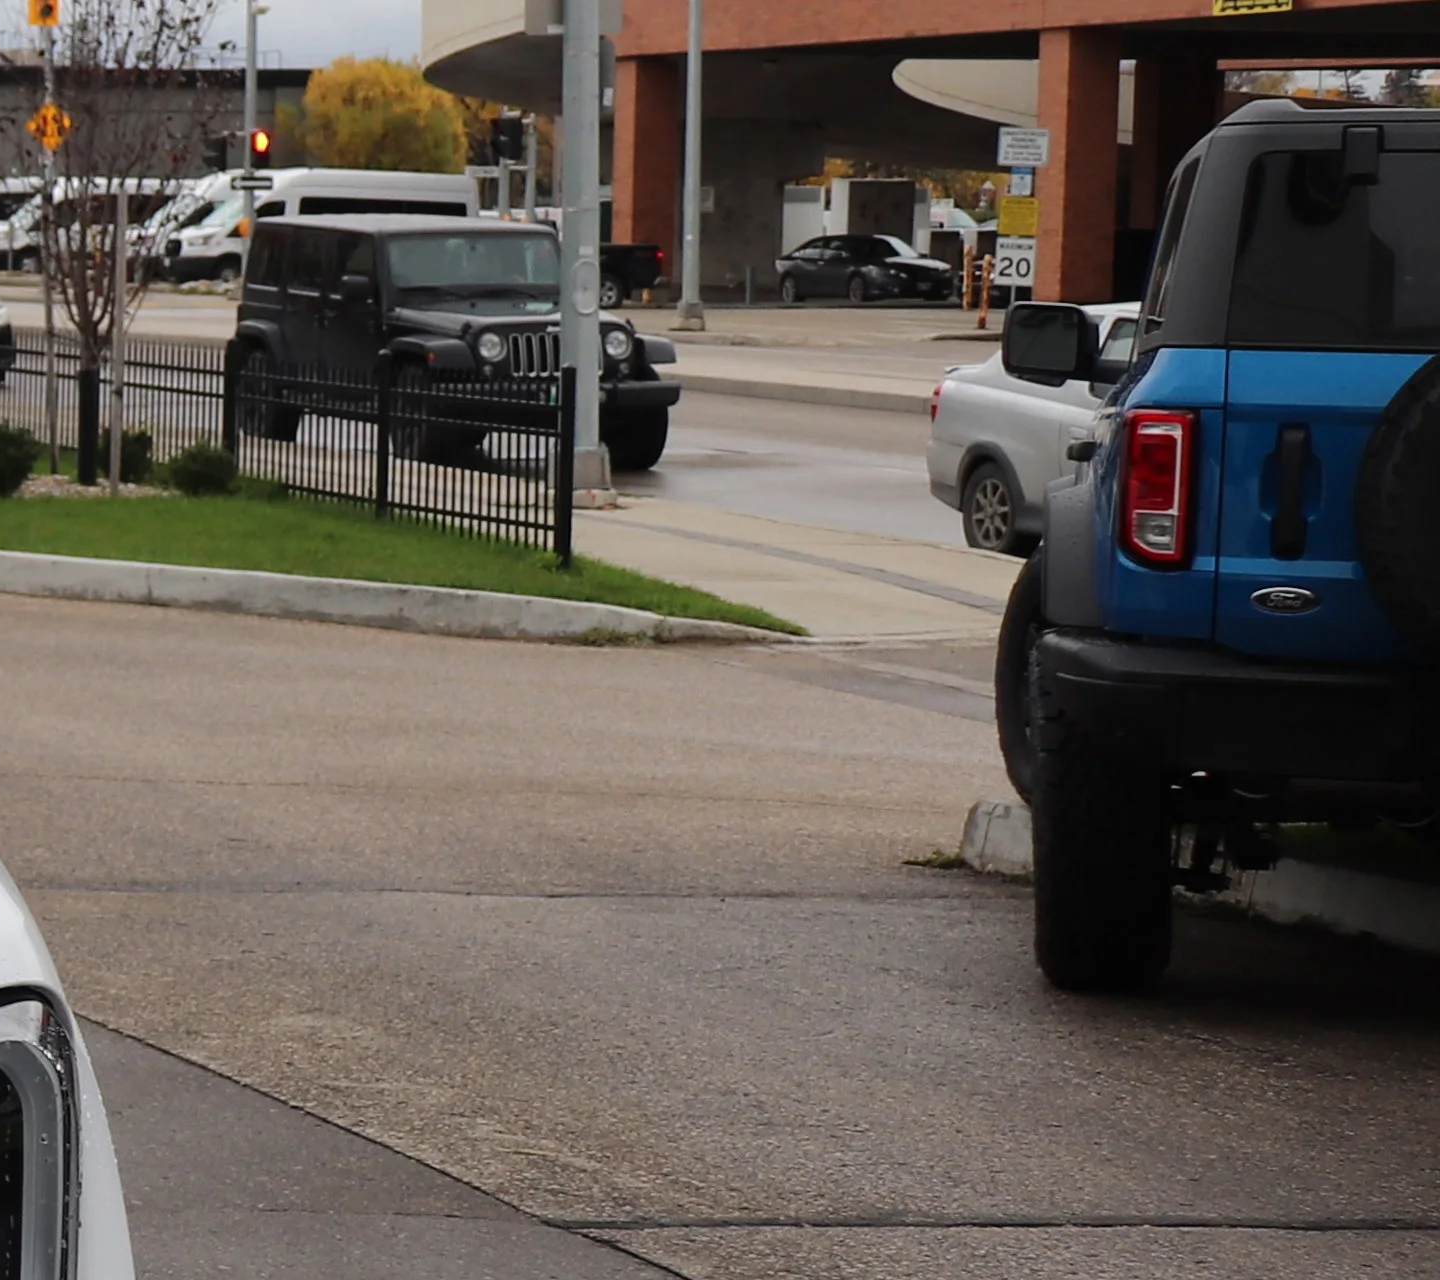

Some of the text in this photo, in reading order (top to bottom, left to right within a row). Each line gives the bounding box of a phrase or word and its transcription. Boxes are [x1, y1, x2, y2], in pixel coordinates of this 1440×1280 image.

[999, 242, 1034, 251] MAXIMUM
[998, 256, 1031, 278] 20
[1266, 592, 1302, 608] Ford
